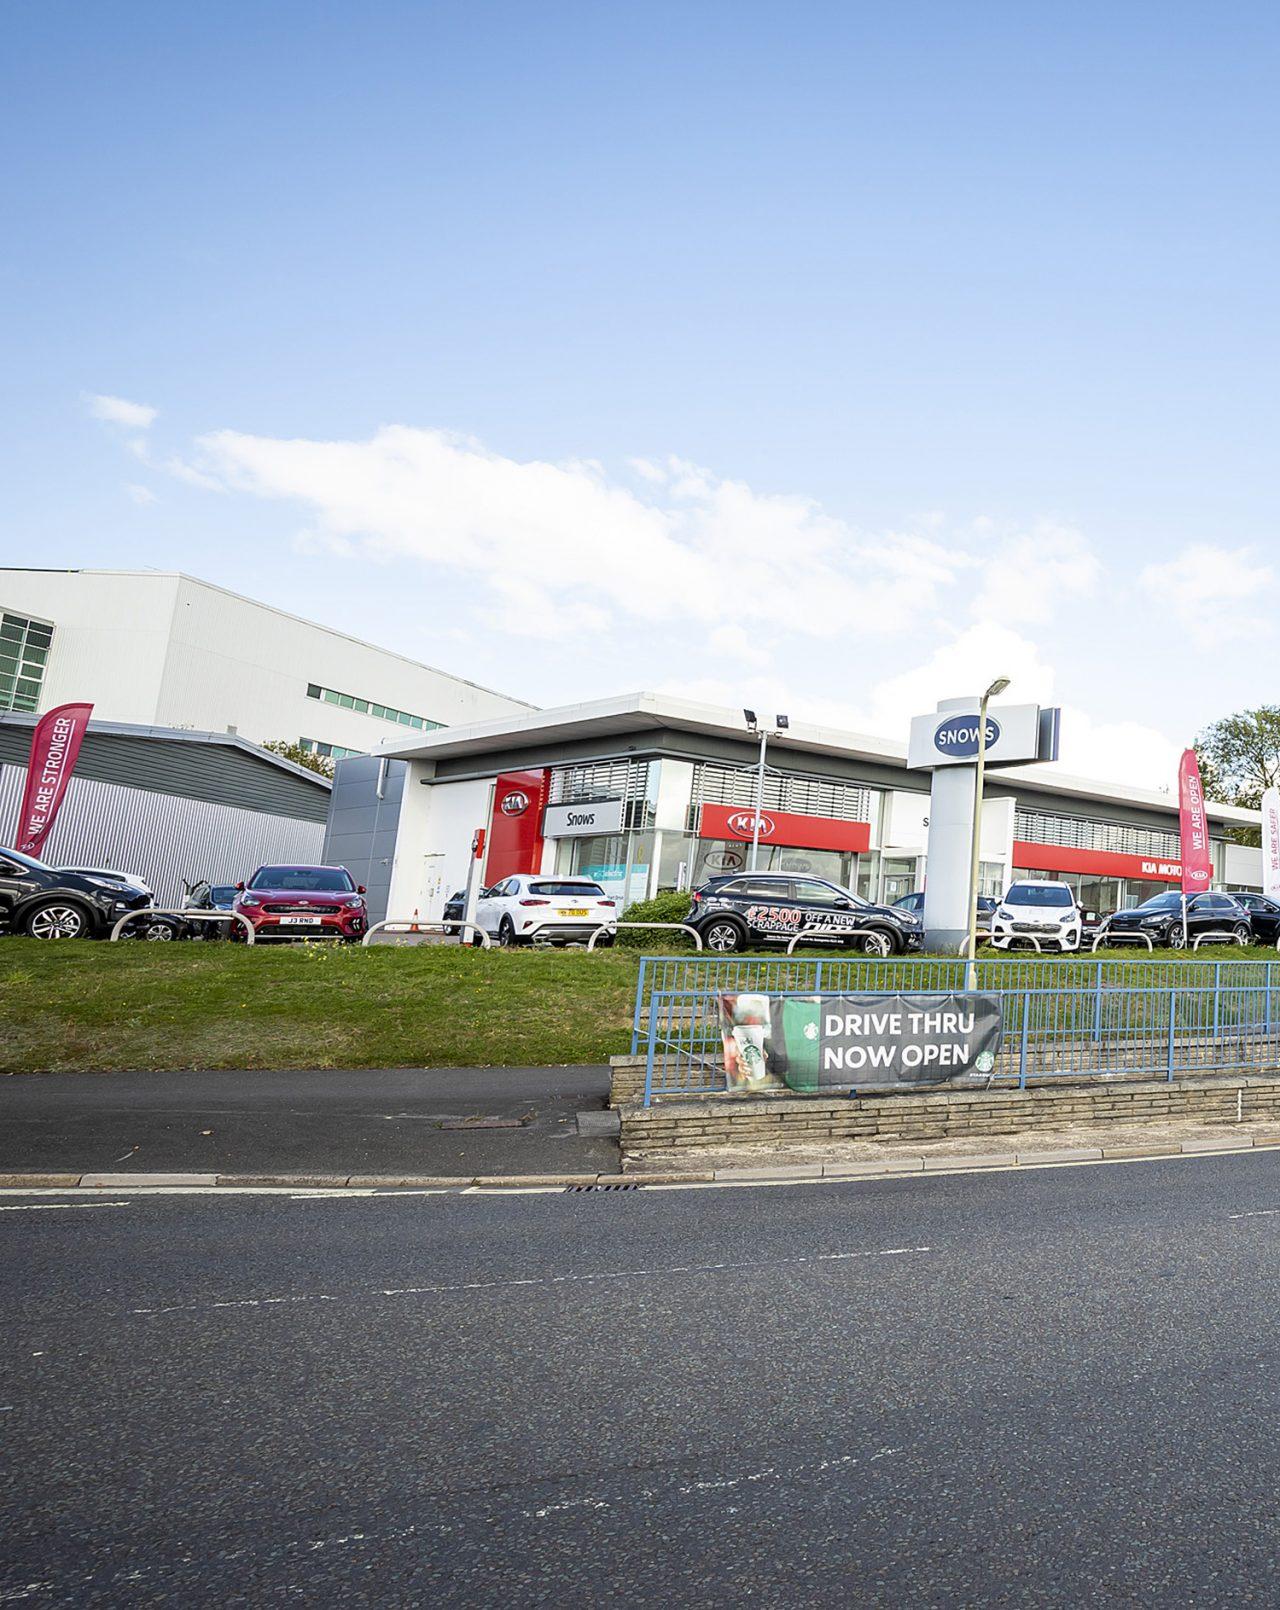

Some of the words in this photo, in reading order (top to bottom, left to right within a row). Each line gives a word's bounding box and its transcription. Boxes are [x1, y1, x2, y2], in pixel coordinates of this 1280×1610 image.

[938, 726, 994, 745] SNOWS
[42, 717, 71, 784] STRONGER
[34, 787, 53, 813] ARE
[1188, 776, 1199, 804] OPEN
[28, 814, 46, 835] WE
[566, 812, 595, 827] Snows
[736, 816, 767, 833] KIA
[1191, 807, 1202, 830] ARE
[1193, 831, 1203, 850] WE
[1141, 861, 1158, 874] KIA
[1158, 863, 1188, 876] MOTO
[747, 919, 800, 931] SCRAPPAGE
[805, 913, 822, 922] OFF
[834, 915, 856, 926] NEW
[825, 1013, 902, 1037] DRIVE
[908, 1012, 975, 1034] THRU
[824, 1045, 897, 1069] NOW
[901, 1043, 970, 1067] OPEN
